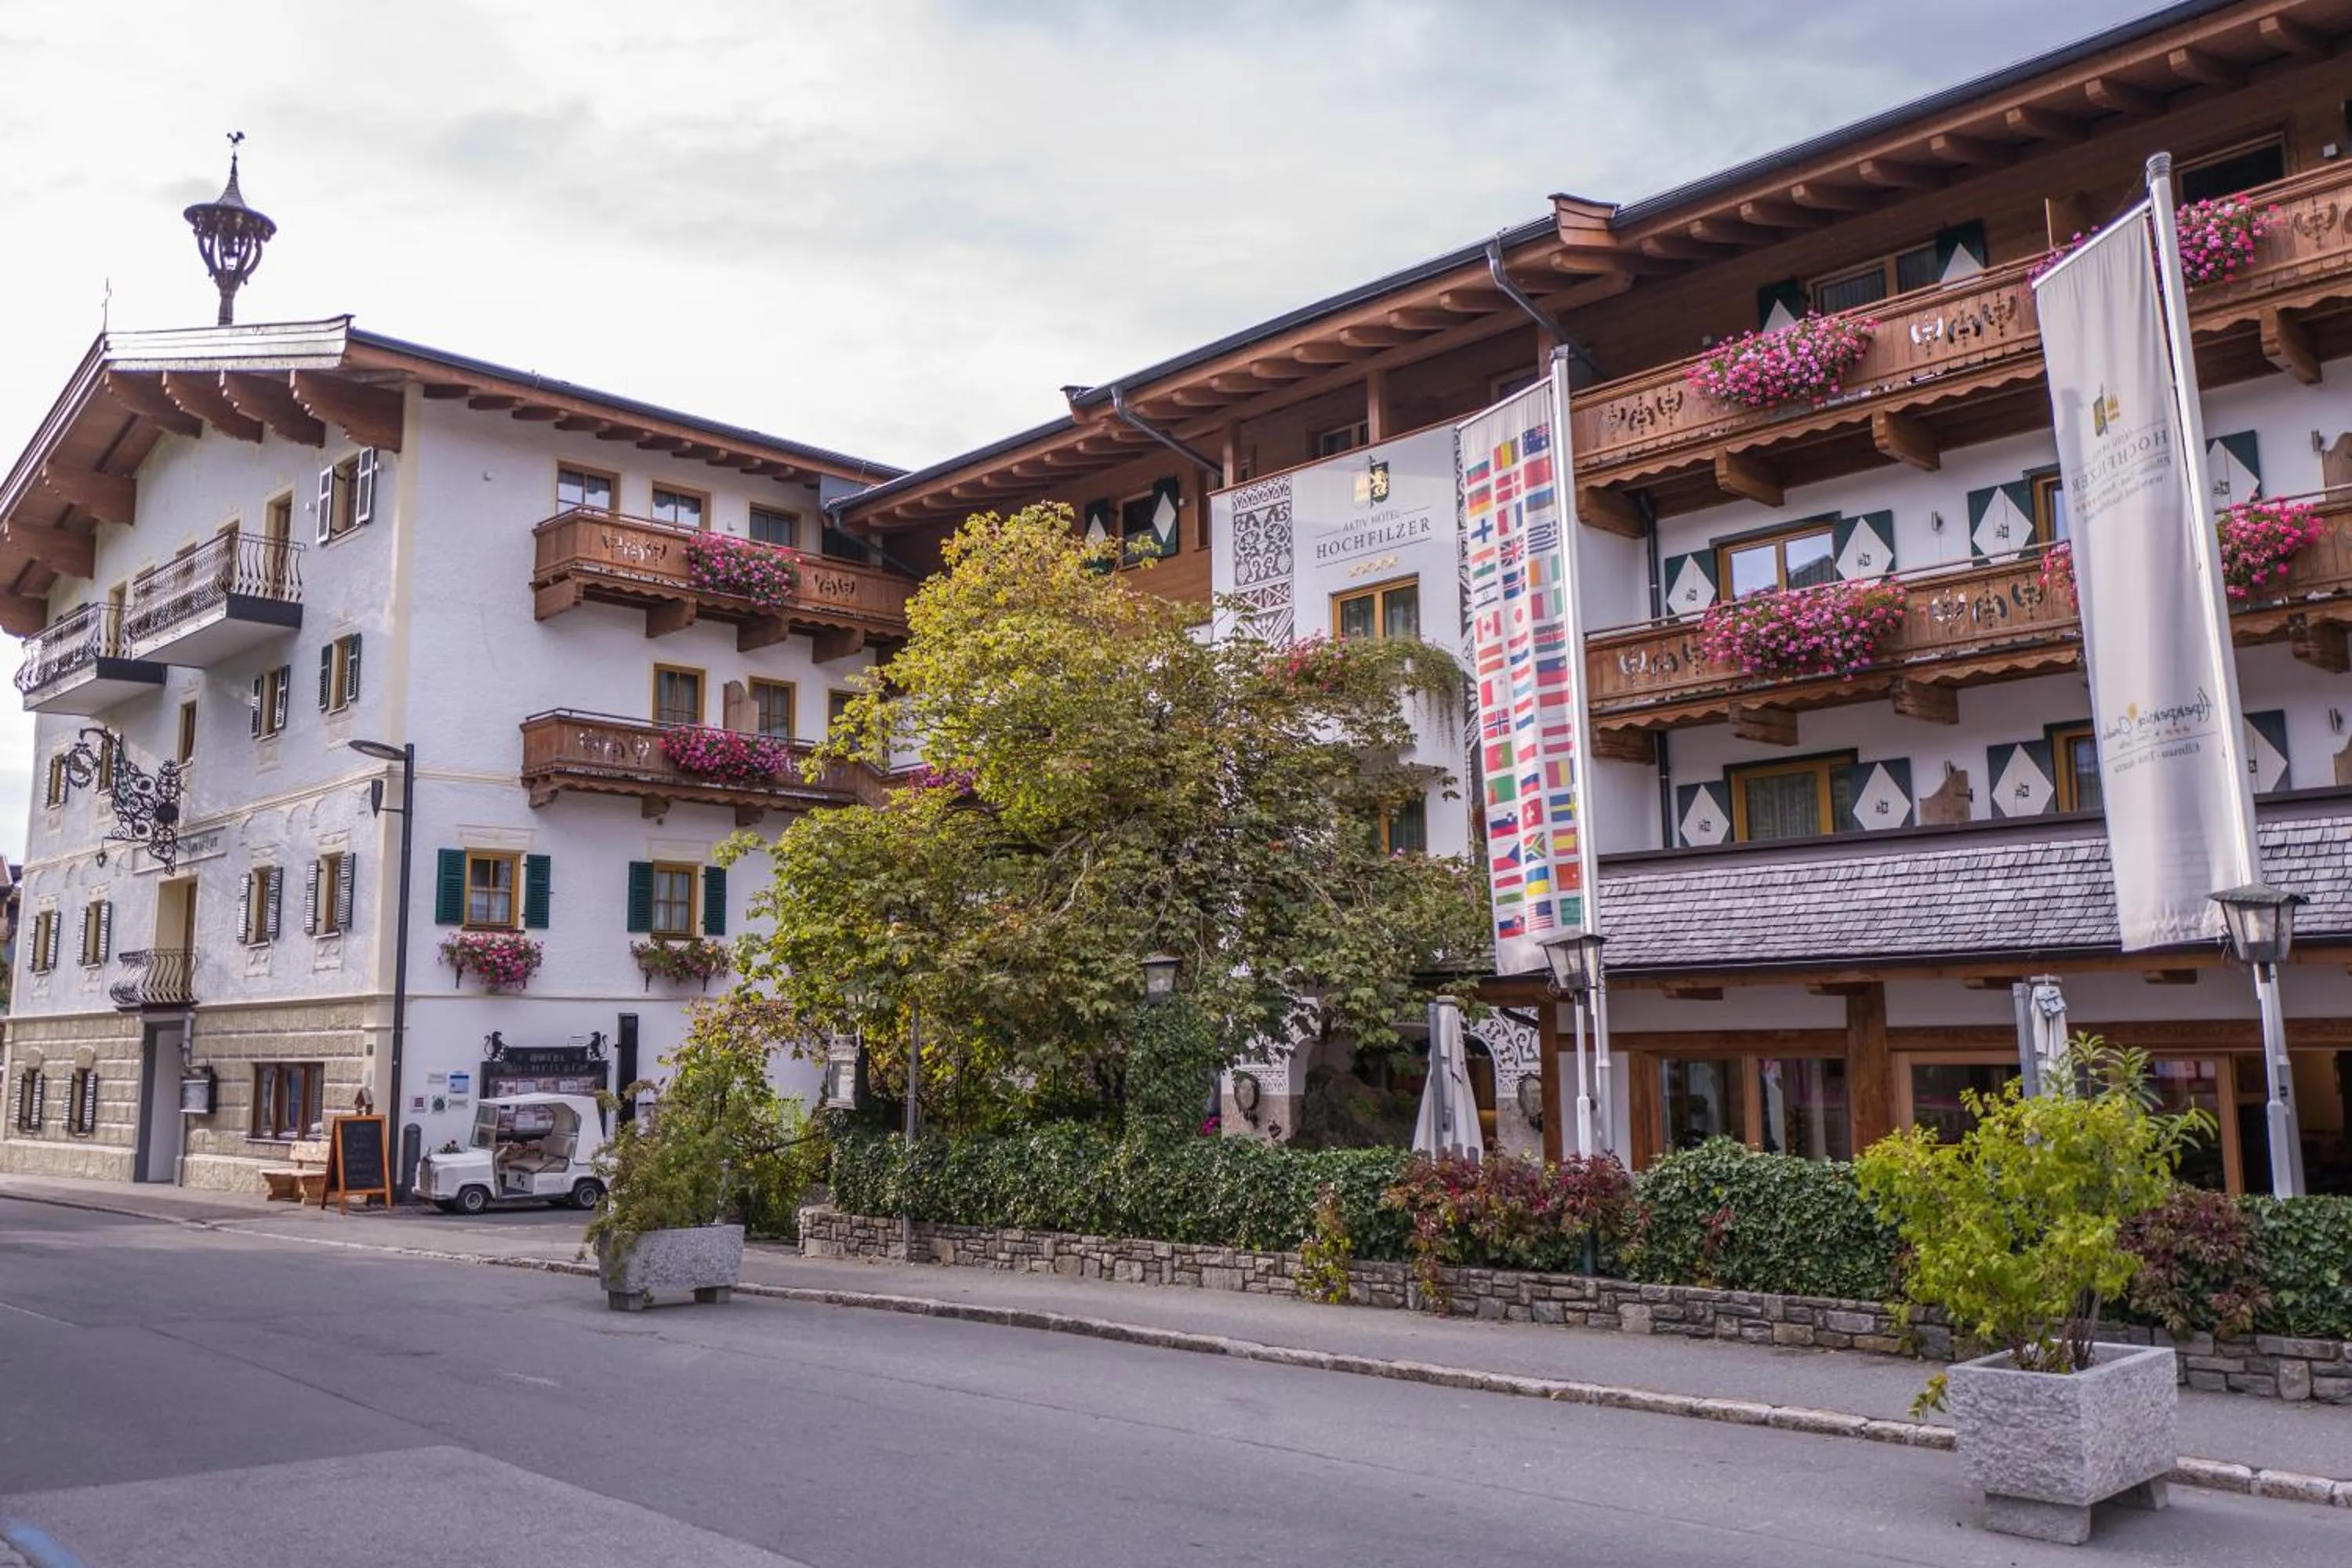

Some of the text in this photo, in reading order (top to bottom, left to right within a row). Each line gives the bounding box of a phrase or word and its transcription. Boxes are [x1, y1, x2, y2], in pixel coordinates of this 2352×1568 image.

[1343, 510, 1400, 532] AKTIV HOTEL
[1316, 516, 1431, 559] HOCHFILZER
